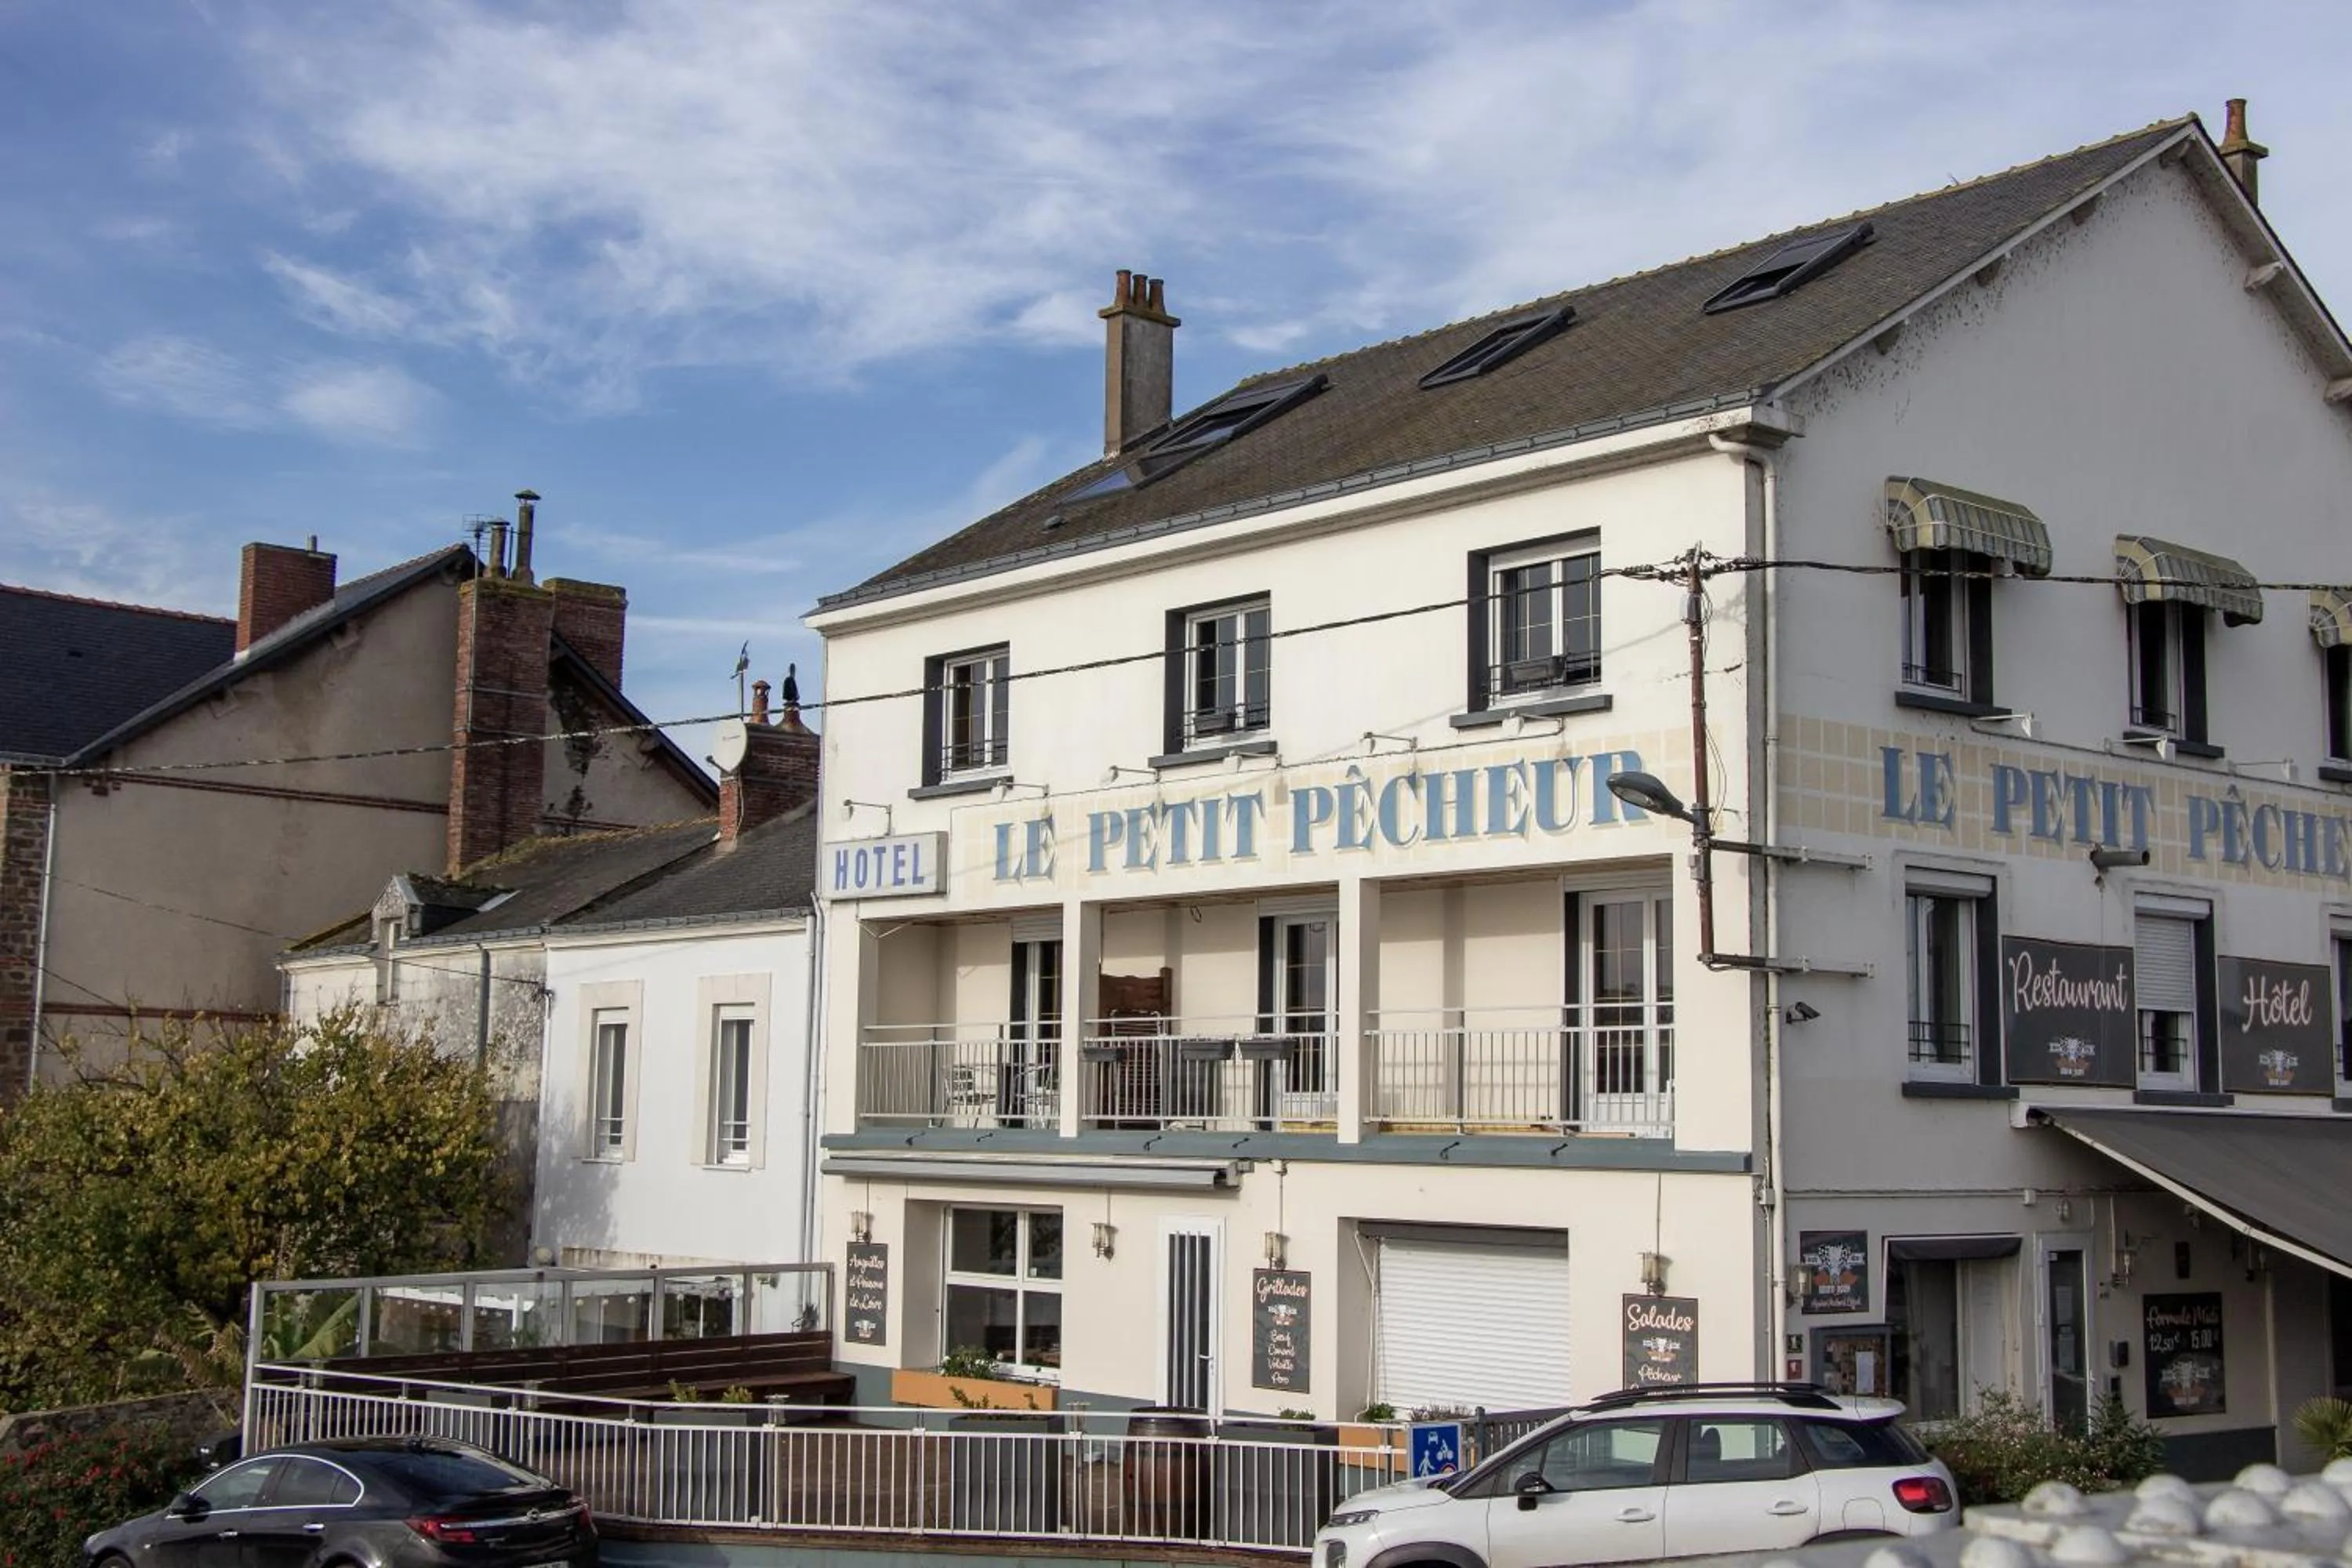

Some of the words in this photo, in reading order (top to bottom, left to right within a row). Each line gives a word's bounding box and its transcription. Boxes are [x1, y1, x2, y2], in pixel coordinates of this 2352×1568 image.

[993, 814, 1055, 886] LE
[1087, 789, 1263, 874] PETIT
[1290, 750, 1649, 855] PÊCHEUR
[1879, 746, 1955, 830] LE
[1990, 764, 2154, 852] PETIT
[2185, 784, 2352, 884] PÊCHE
[835, 843, 925, 891] HOTEL
[2009, 951, 2129, 1014] Restaurant
[2241, 975, 2313, 1033] Hôtel
[1257, 1276, 1308, 1303] Grillades
[1628, 1303, 1693, 1332] Salades
[1268, 1343, 1295, 1357] Canard
